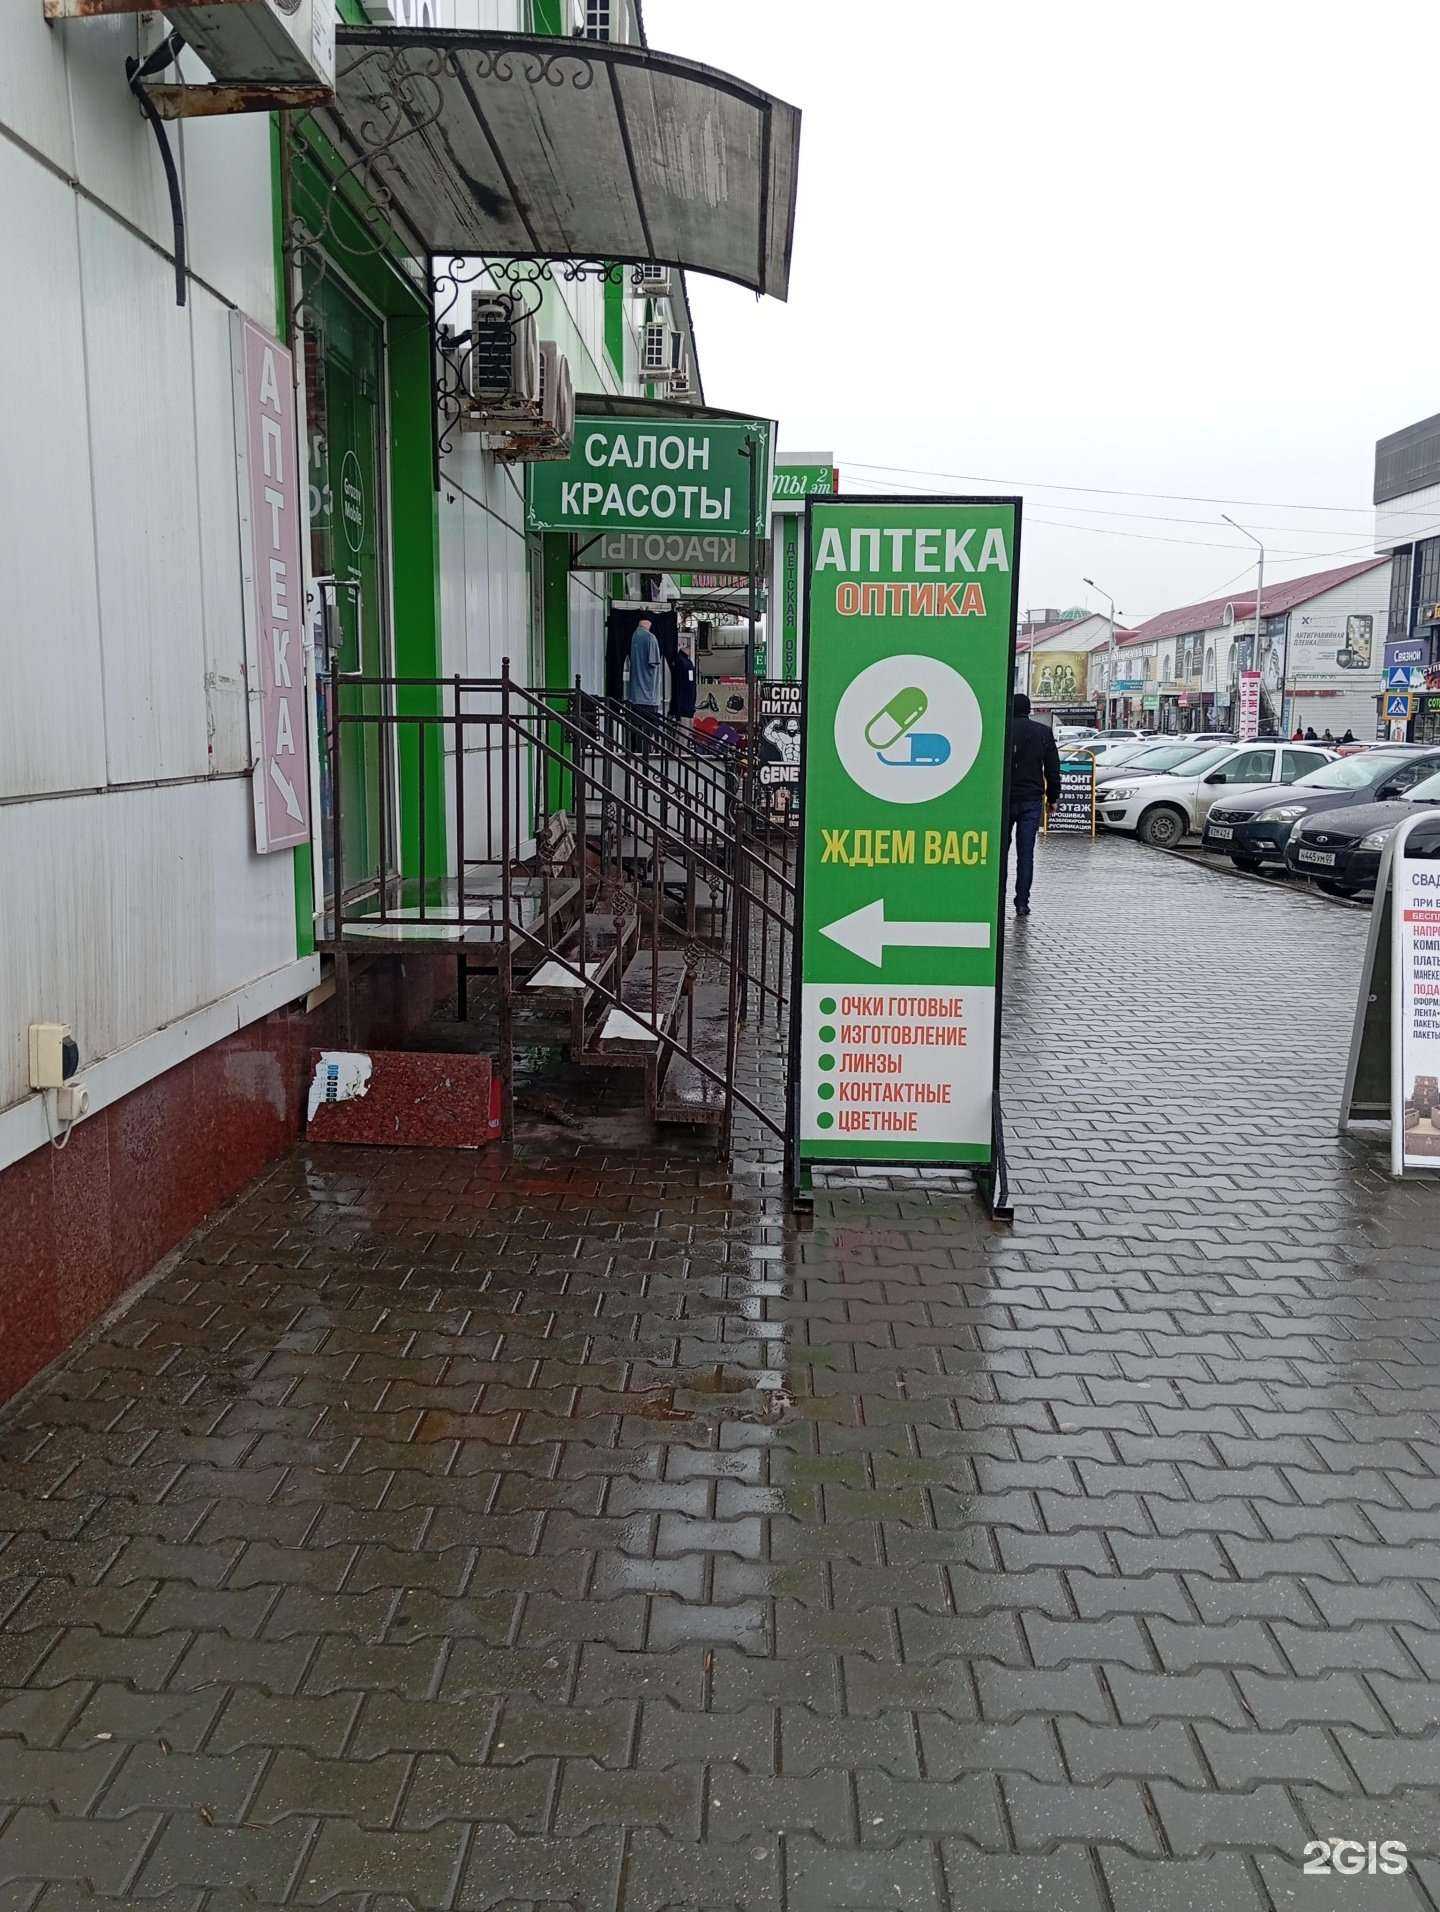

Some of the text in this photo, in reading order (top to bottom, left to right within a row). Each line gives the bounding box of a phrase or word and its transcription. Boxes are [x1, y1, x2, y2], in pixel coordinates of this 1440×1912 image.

[584, 433, 710, 471] САЛОН
[817, 468, 828, 482] 2
[561, 481, 731, 519] КРАСОТЫ
[259, 346, 295, 756] АПТЕКА
[815, 528, 1009, 572] АПТЕКА
[786, 543, 795, 626] ДЕТСКАЯ
[836, 582, 987, 616] ОПТИКА
[821, 829, 988, 867] ЖДЕМ ВАС!
[841, 997, 963, 1018] ОЧКИ ГОТОВЫЕ
[840, 1024, 967, 1046] ИЗГОТОВЛЕНИЕ
[839, 1053, 902, 1074] ЛИНЗЫ
[839, 1082, 951, 1104] КОНТАКТНЫЕ
[838, 1110, 918, 1132] ЦВЕТНЫЕ
